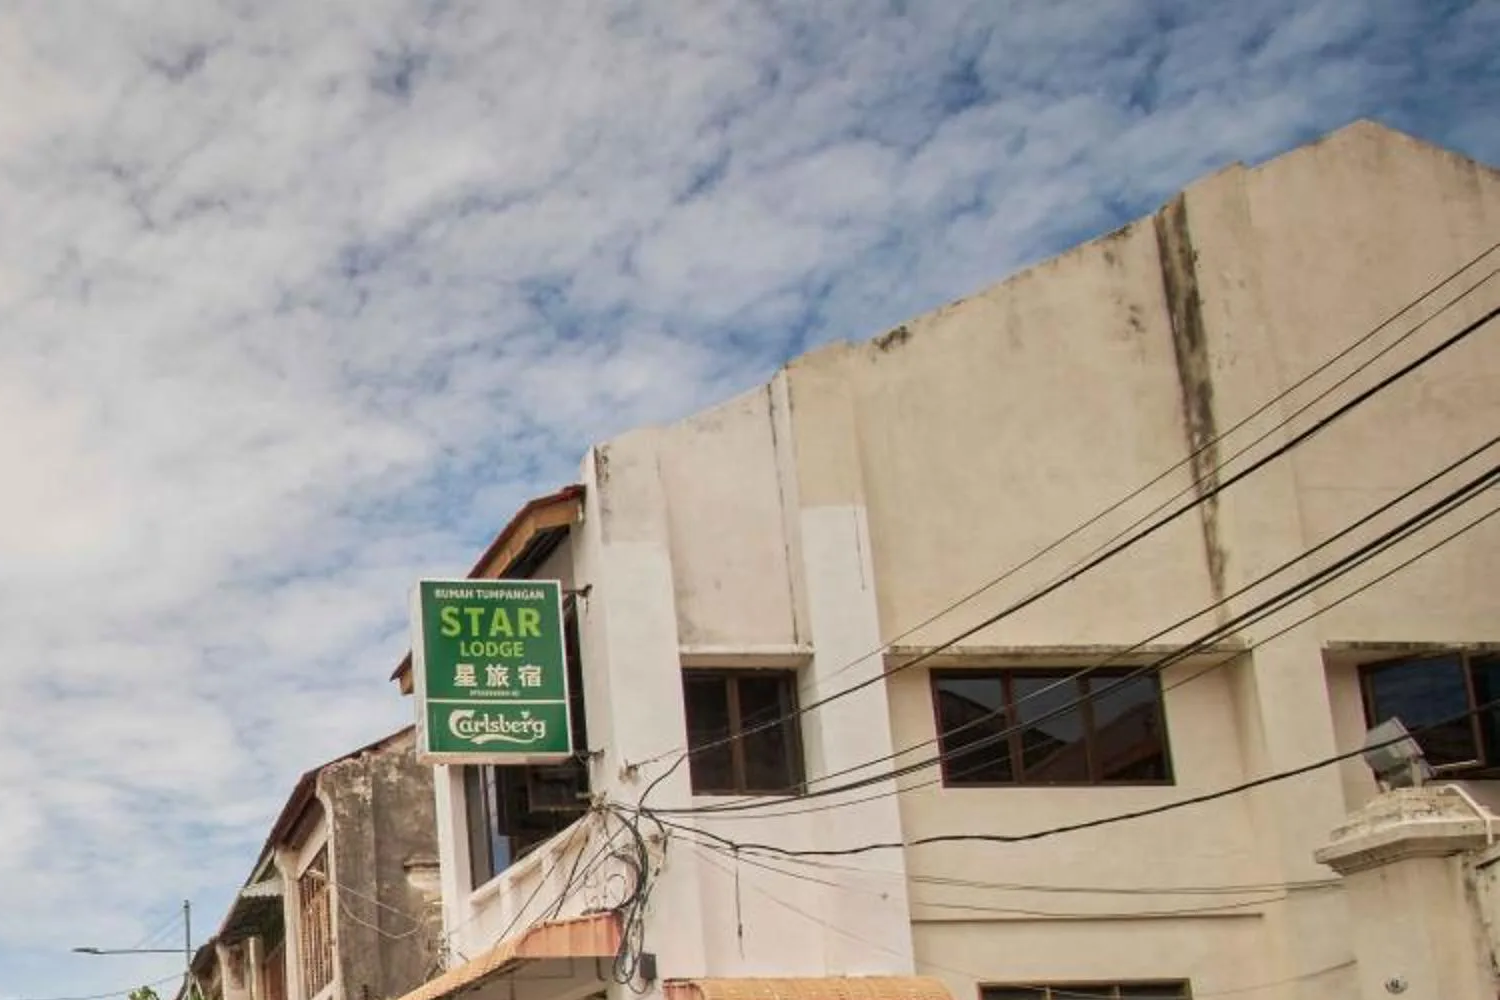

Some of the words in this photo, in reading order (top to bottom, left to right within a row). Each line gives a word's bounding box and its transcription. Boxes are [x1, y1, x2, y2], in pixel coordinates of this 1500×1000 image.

[435, 588, 474, 599] RUMAH
[476, 589, 545, 600] TUMPANGAN
[440, 606, 542, 637] STAR
[460, 641, 525, 657] LODGE
[453, 663, 542, 688] 星旅宿
[448, 709, 547, 744] Carlsberg
